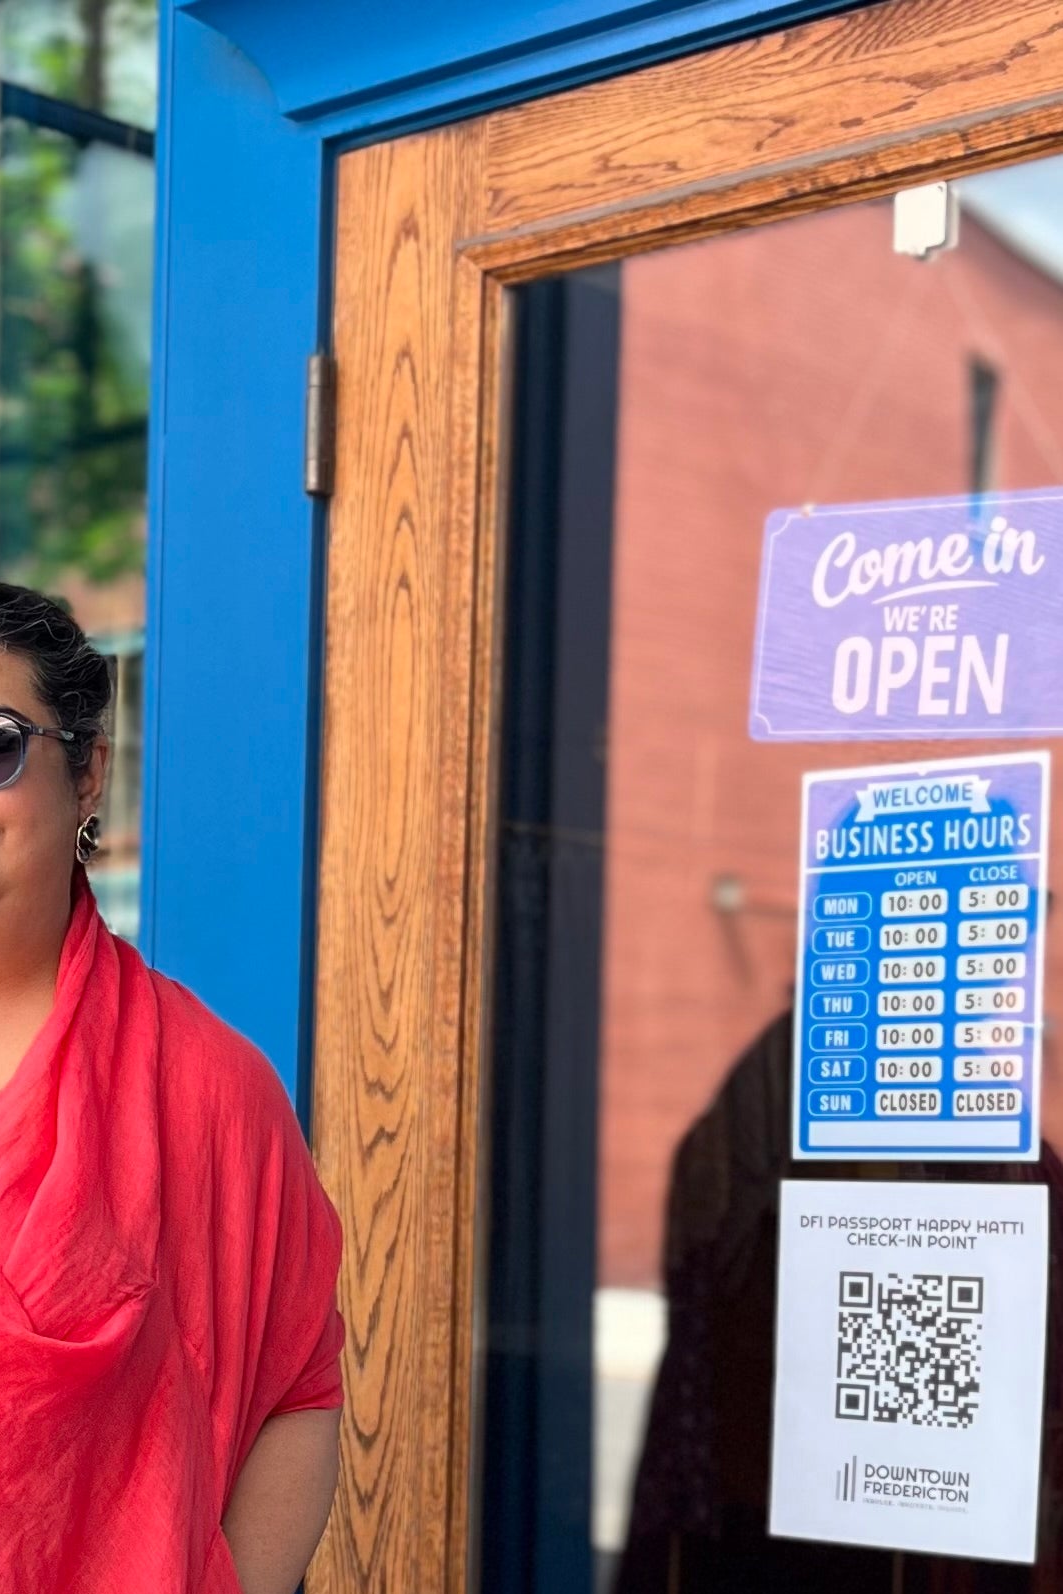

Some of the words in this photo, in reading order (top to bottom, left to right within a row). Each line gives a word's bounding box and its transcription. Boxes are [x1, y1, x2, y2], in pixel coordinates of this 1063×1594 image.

[812, 531, 974, 608] Come
[983, 516, 1045, 575] in
[883, 604, 959, 632] WE'RE
[832, 633, 1009, 716] OPEN
[873, 782, 974, 808] WELCOME
[816, 821, 934, 860] BUSINESS
[944, 813, 1032, 851] HOURS
[894, 871, 937, 886] OPEN
[969, 865, 1018, 882] CLOSE
[824, 898, 858, 915] MON
[826, 930, 855, 948] TUE
[821, 964, 856, 981] WED
[823, 997, 853, 1013] THU
[825, 1030, 849, 1047] FRI
[821, 1061, 851, 1077] SAT
[819, 1095, 851, 1111] SUN
[879, 1093, 937, 1112] CLOSED
[956, 1092, 1016, 1113] CLOSED
[800, 1215, 823, 1228] DFI
[828, 1216, 912, 1231] PASSPORT
[917, 1218, 971, 1233] HAPPY
[976, 1220, 1024, 1235] HATTI
[847, 1232, 922, 1248] CHECK-IN
[927, 1236, 977, 1250] POINT
[864, 1463, 970, 1487] DOWNTOWN
[863, 1480, 969, 1503] FREDERICTON
